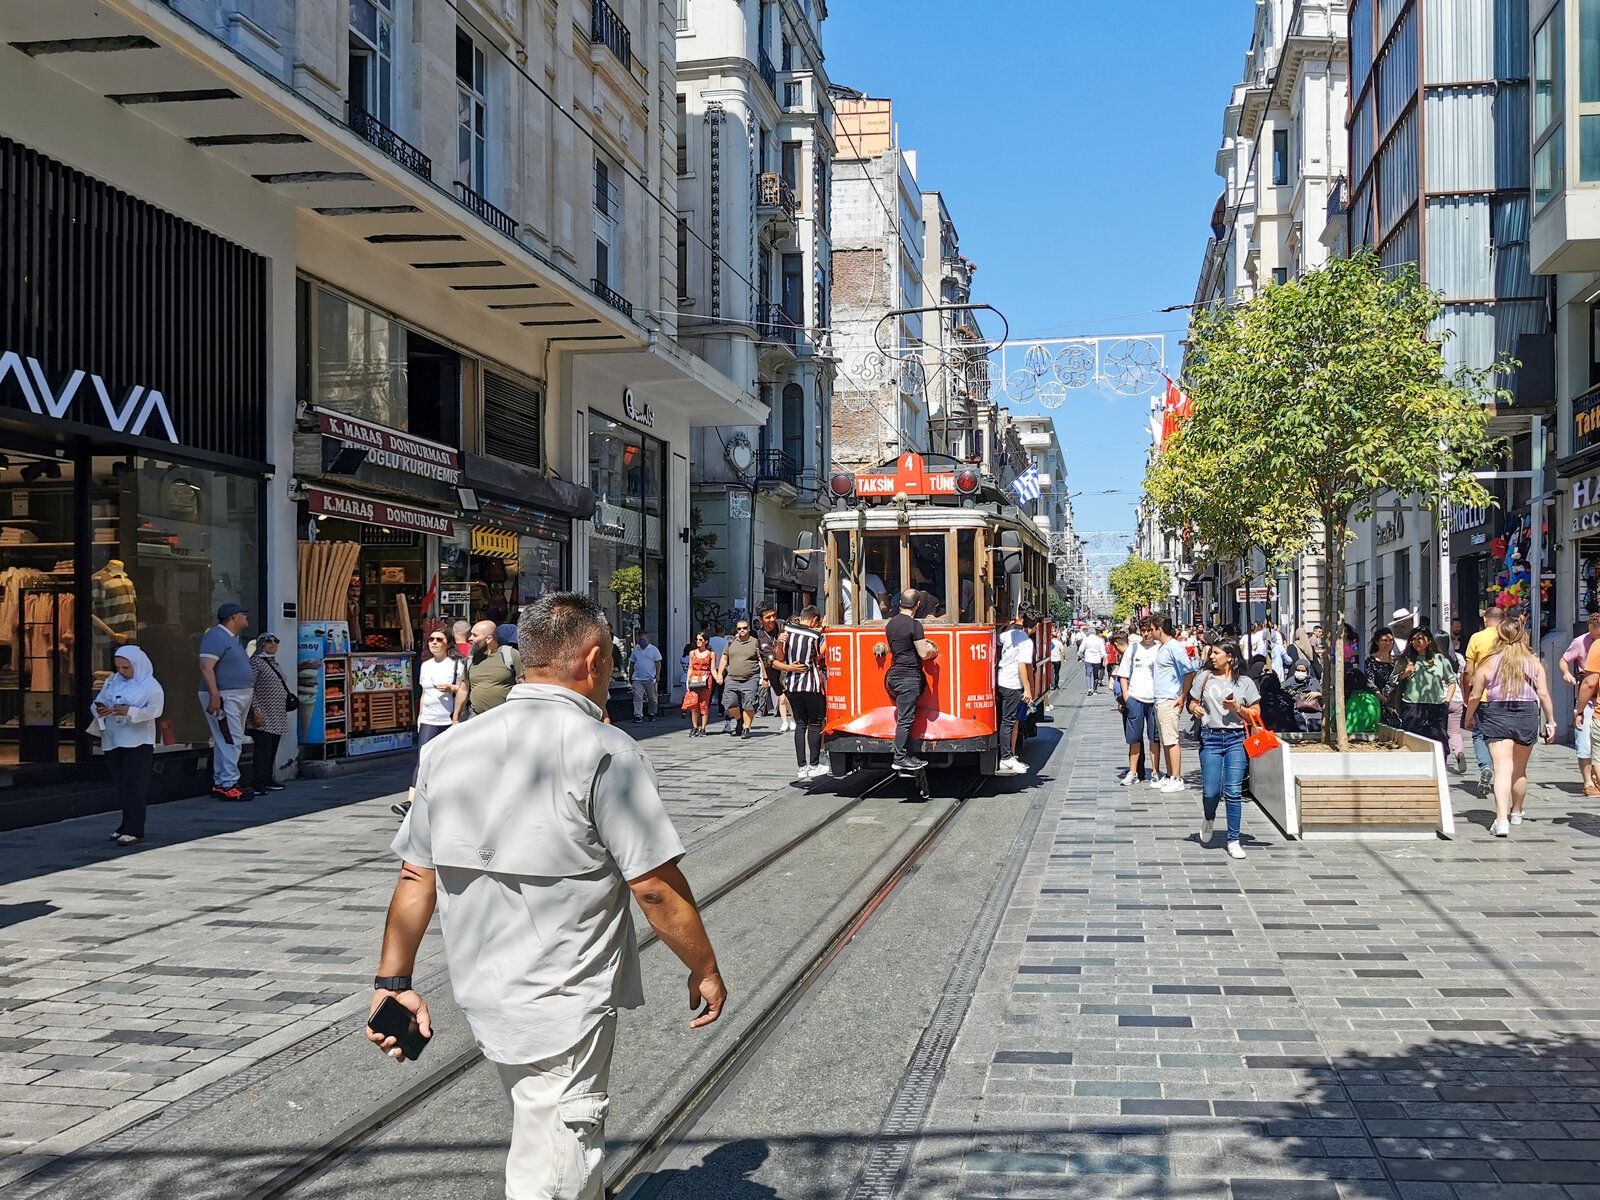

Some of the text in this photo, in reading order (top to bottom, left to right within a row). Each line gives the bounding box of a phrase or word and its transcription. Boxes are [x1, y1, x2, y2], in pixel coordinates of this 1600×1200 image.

[389, 436, 451, 465] DONDURMASI
[905, 455, 913, 471] 4
[386, 507, 448, 532] DONDURMASI
[828, 646, 842, 662] 115
[969, 643, 987, 660] 115
